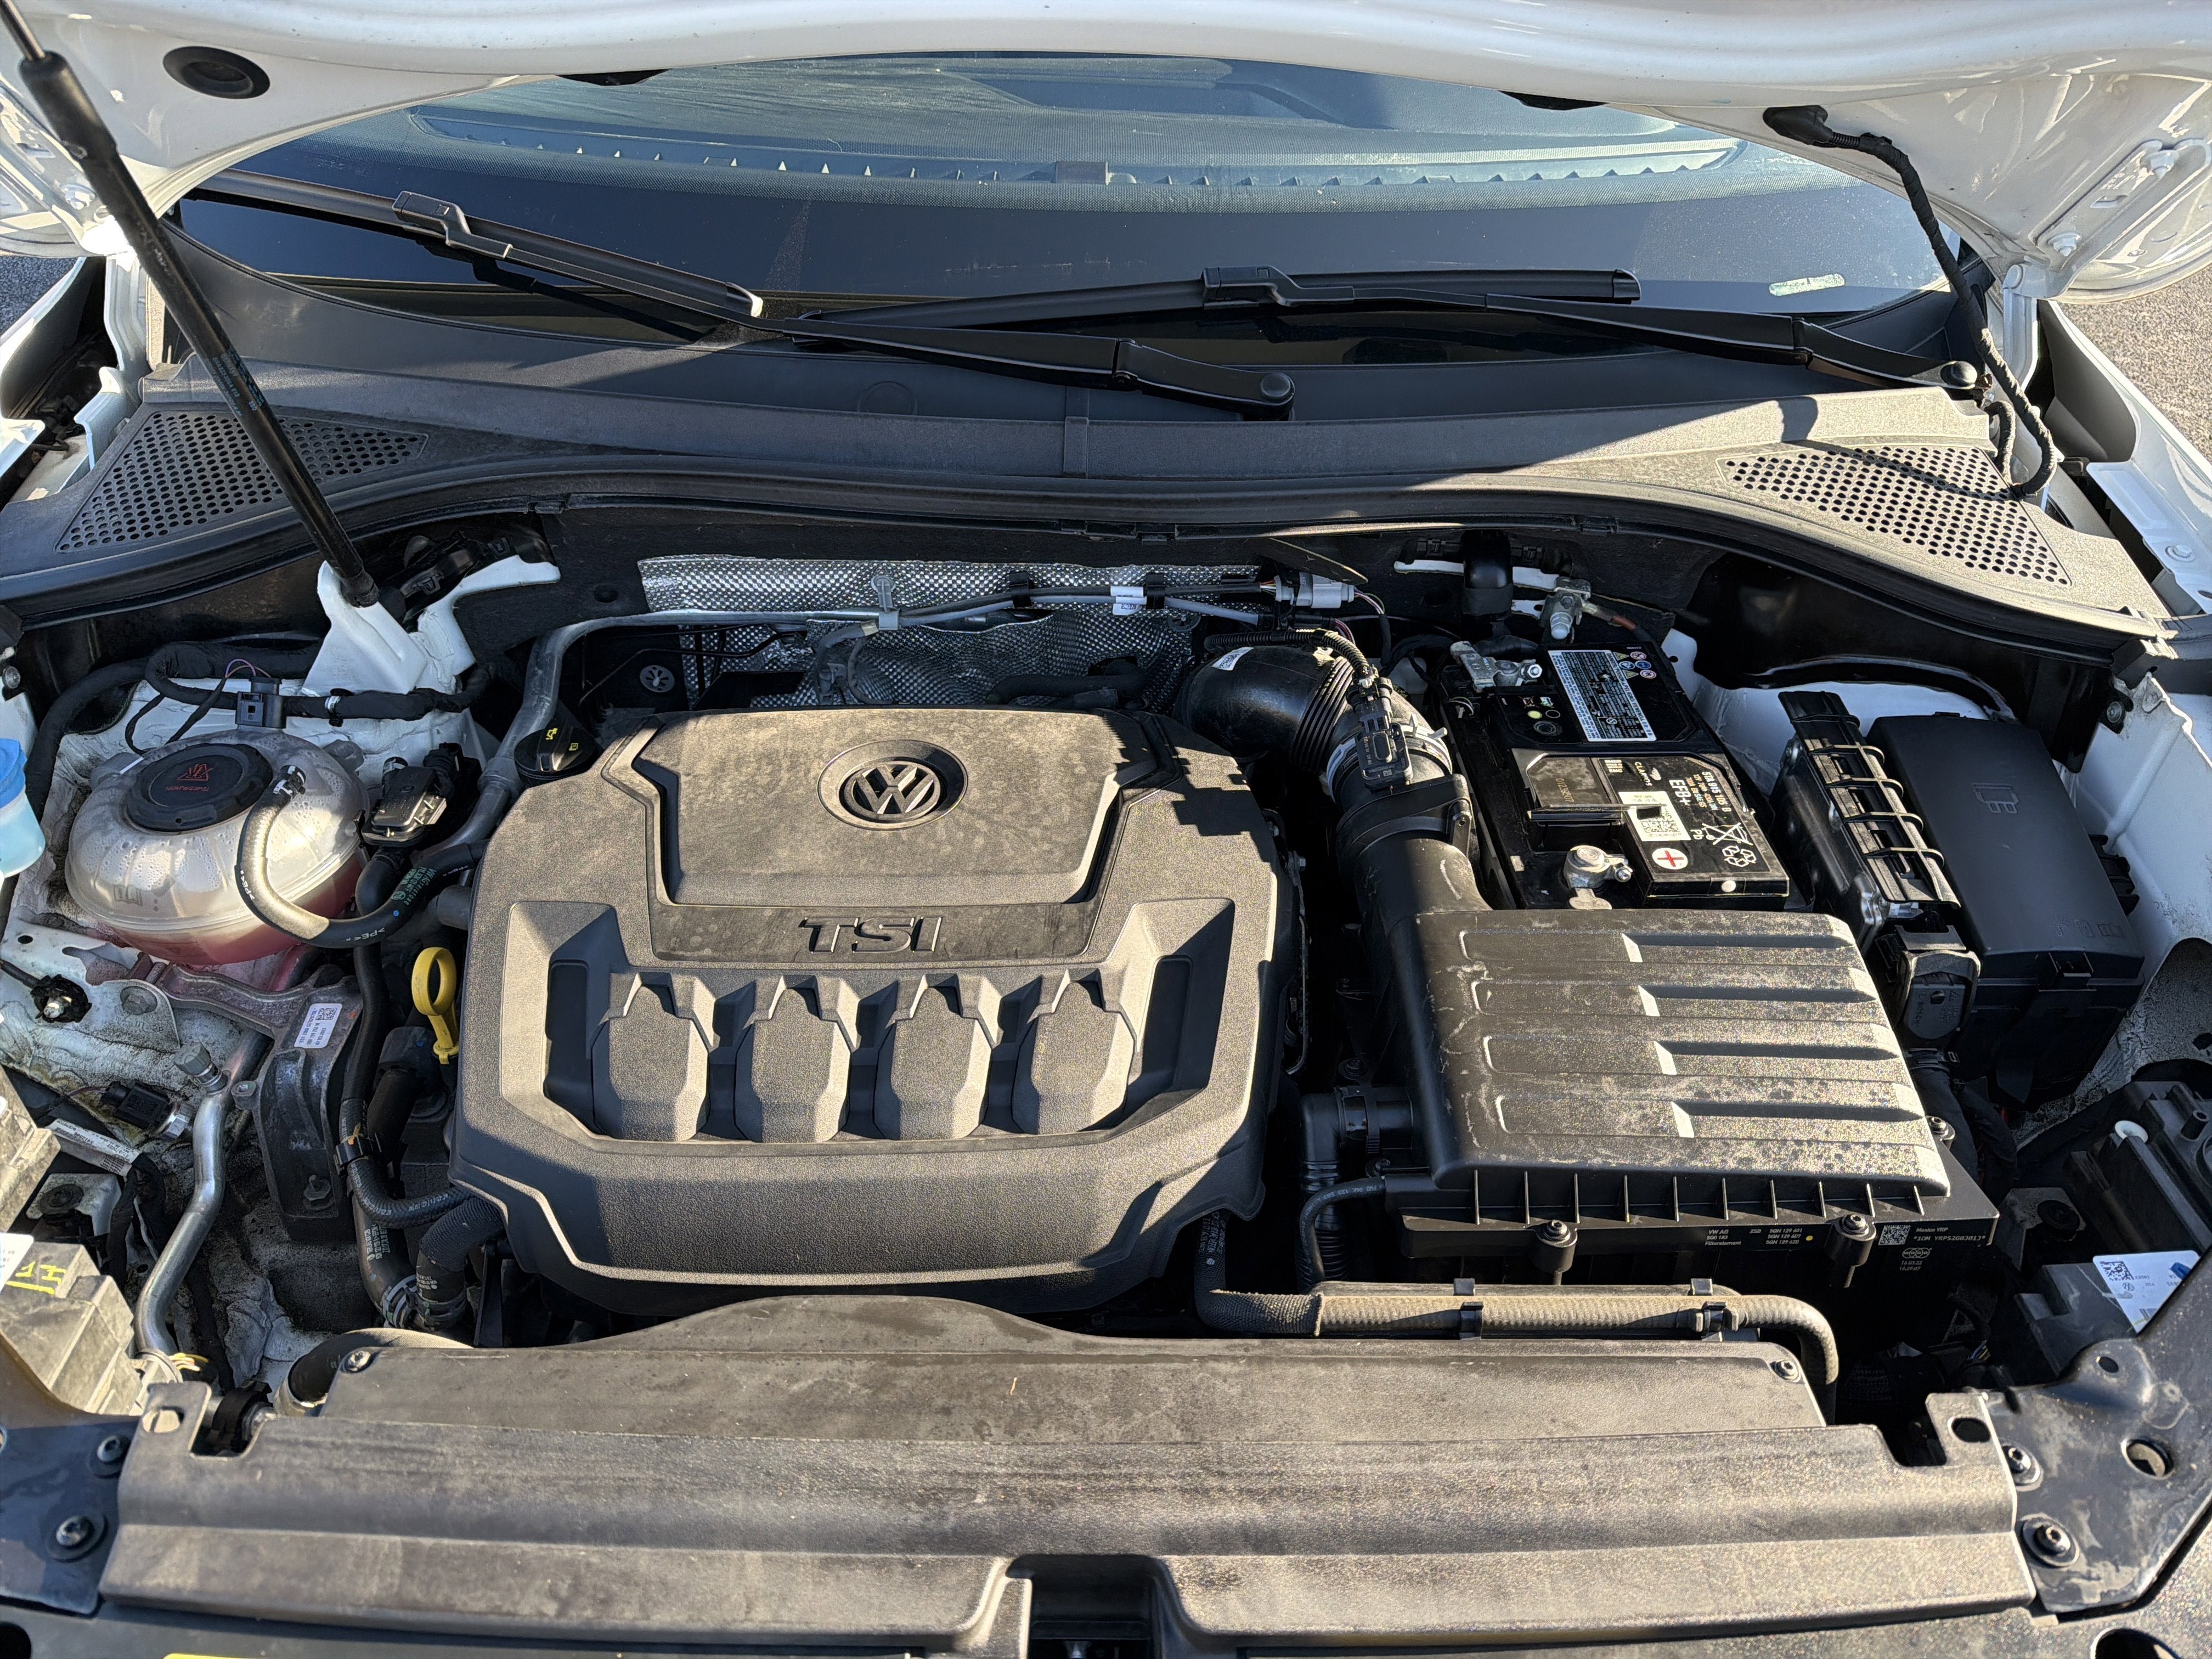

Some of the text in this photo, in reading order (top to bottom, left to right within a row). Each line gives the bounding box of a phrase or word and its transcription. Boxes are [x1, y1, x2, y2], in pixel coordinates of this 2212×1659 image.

[1669, 779, 1692, 805] EFB+
[1709, 782, 1721, 793] 915
[1690, 828, 1704, 840] Pb
[798, 916, 943, 954] TSI
